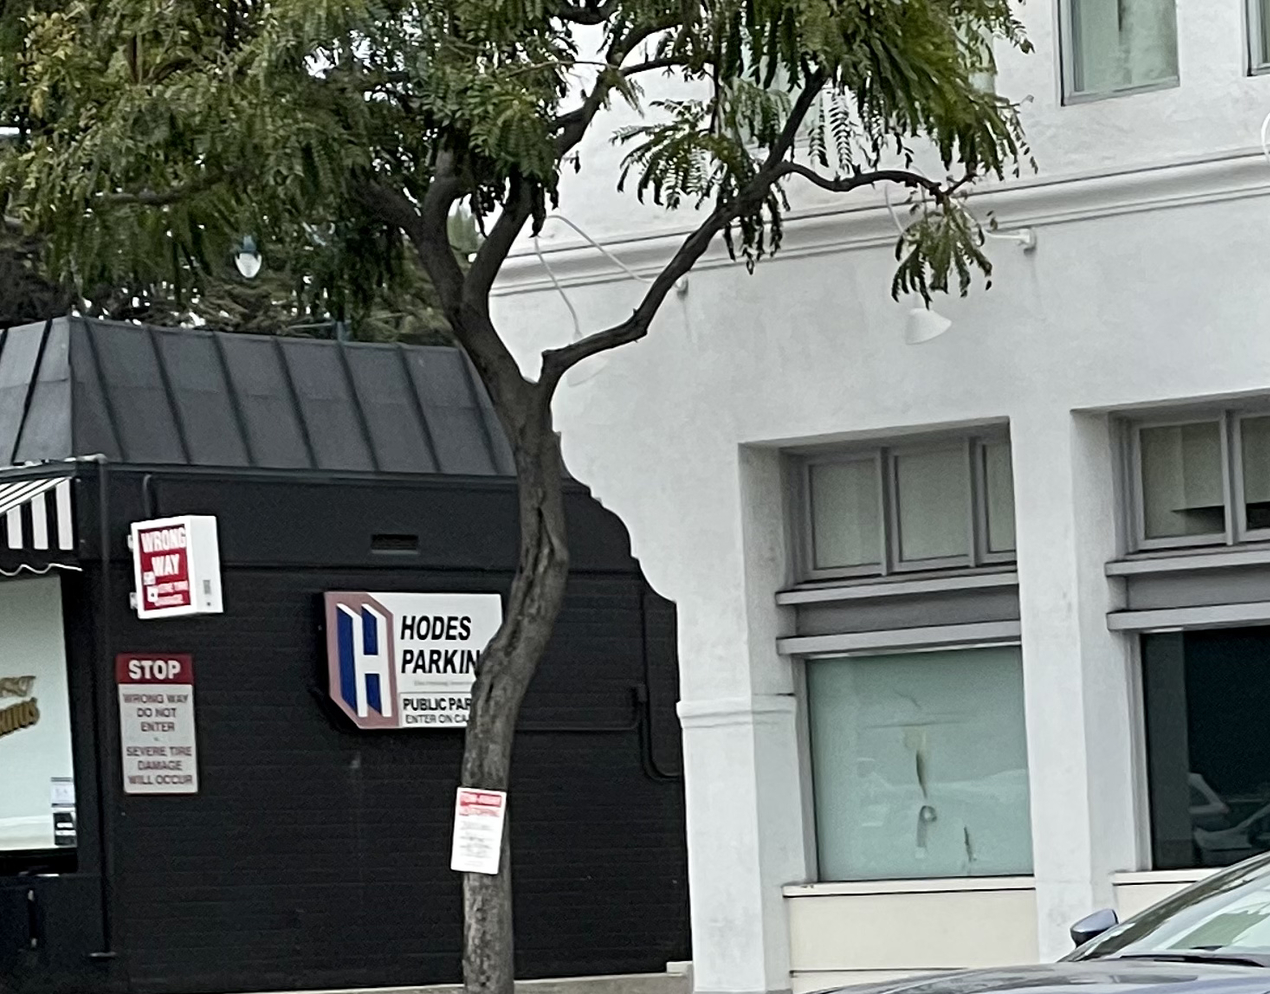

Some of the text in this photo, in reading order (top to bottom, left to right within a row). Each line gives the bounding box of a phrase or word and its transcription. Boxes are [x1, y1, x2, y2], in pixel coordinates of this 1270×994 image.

[141, 527, 187, 553] WRONG
[151, 553, 180, 577] WAY
[400, 615, 472, 641] HODES
[401, 649, 480, 674] PARKIN
[128, 659, 181, 680] STOP
[123, 693, 189, 703] WRONG WAY
[403, 697, 472, 711] PUBLIC PAR
[137, 707, 176, 717] DO NOT
[405, 713, 436, 724] ENTER
[438, 713, 453, 724] ON
[140, 721, 175, 732] ENTER
[126, 745, 193, 757] SEVERE TIRE
[137, 760, 183, 771] DAMAGE
[127, 774, 193, 785] WILL OCCUR
